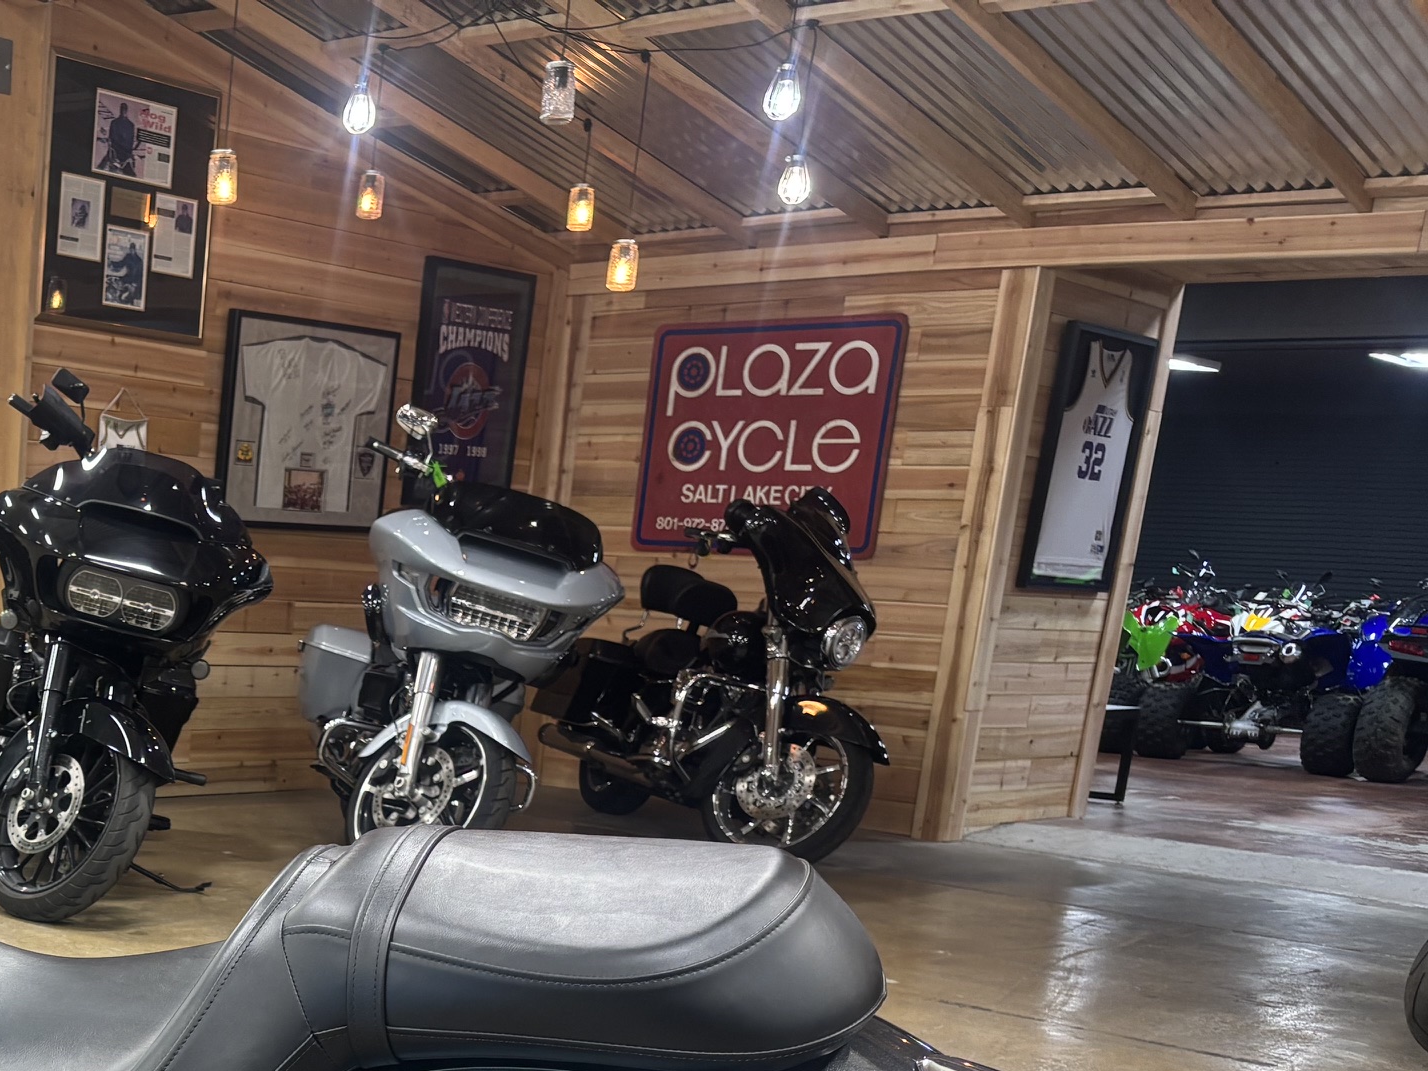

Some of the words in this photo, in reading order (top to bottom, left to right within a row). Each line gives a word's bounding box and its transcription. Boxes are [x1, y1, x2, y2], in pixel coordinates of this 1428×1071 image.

[439, 325, 510, 362] CHAMPIONS
[1077, 440, 1107, 482] 32
[680, 483, 728, 504] SALT
